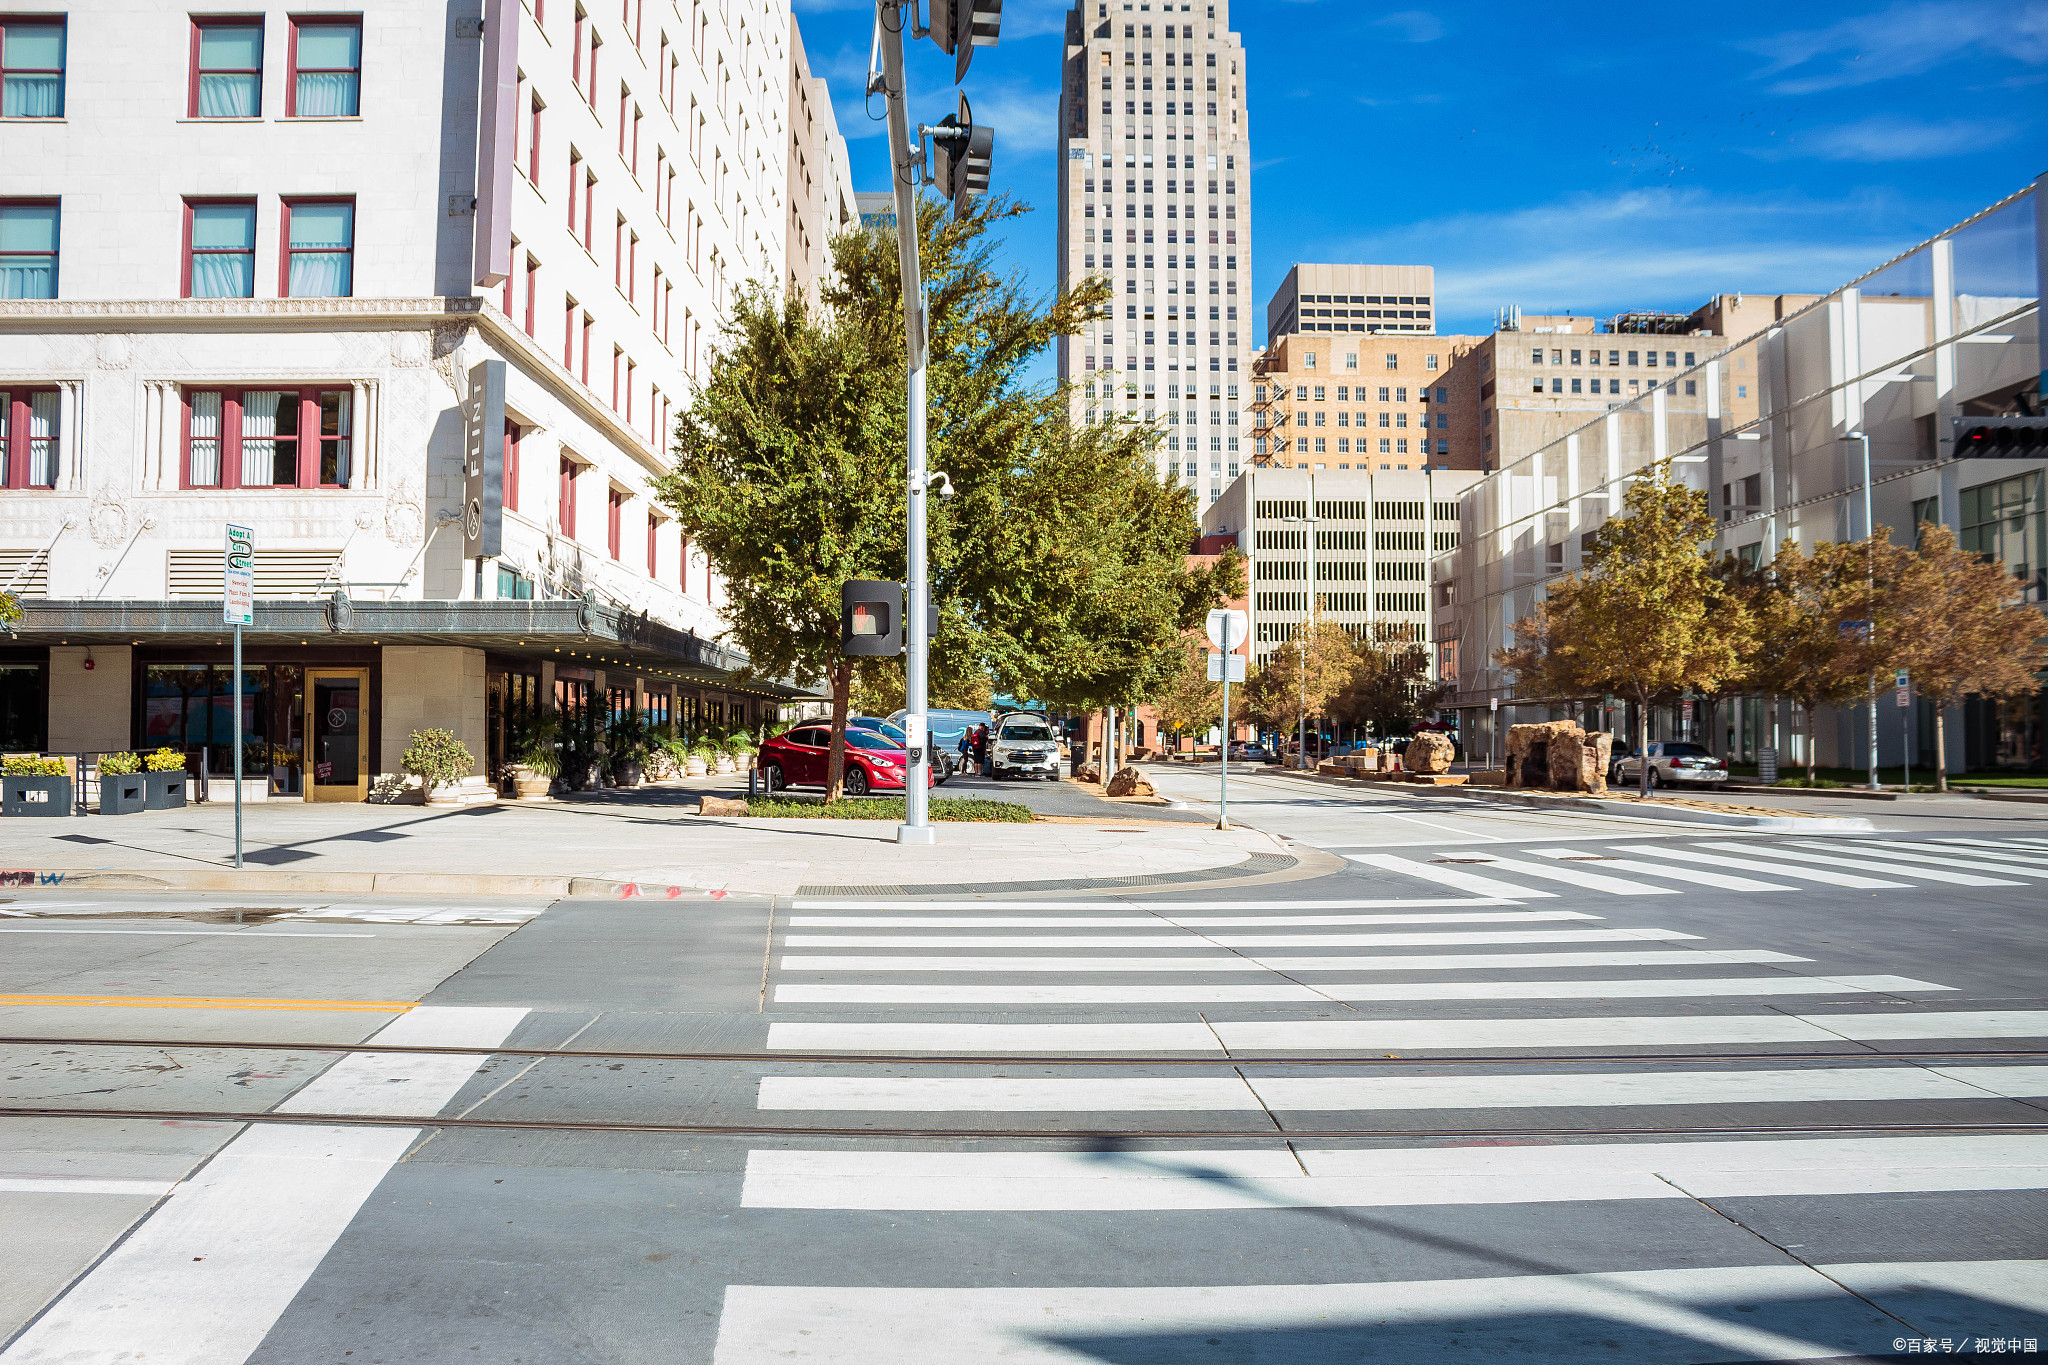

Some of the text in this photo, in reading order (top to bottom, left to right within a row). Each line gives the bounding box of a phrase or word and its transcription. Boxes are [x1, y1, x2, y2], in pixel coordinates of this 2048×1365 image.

[470, 381, 482, 477] FLINT
[229, 528, 245, 539] Adopt
[232, 543, 244, 553] City
[235, 558, 252, 568] Street
